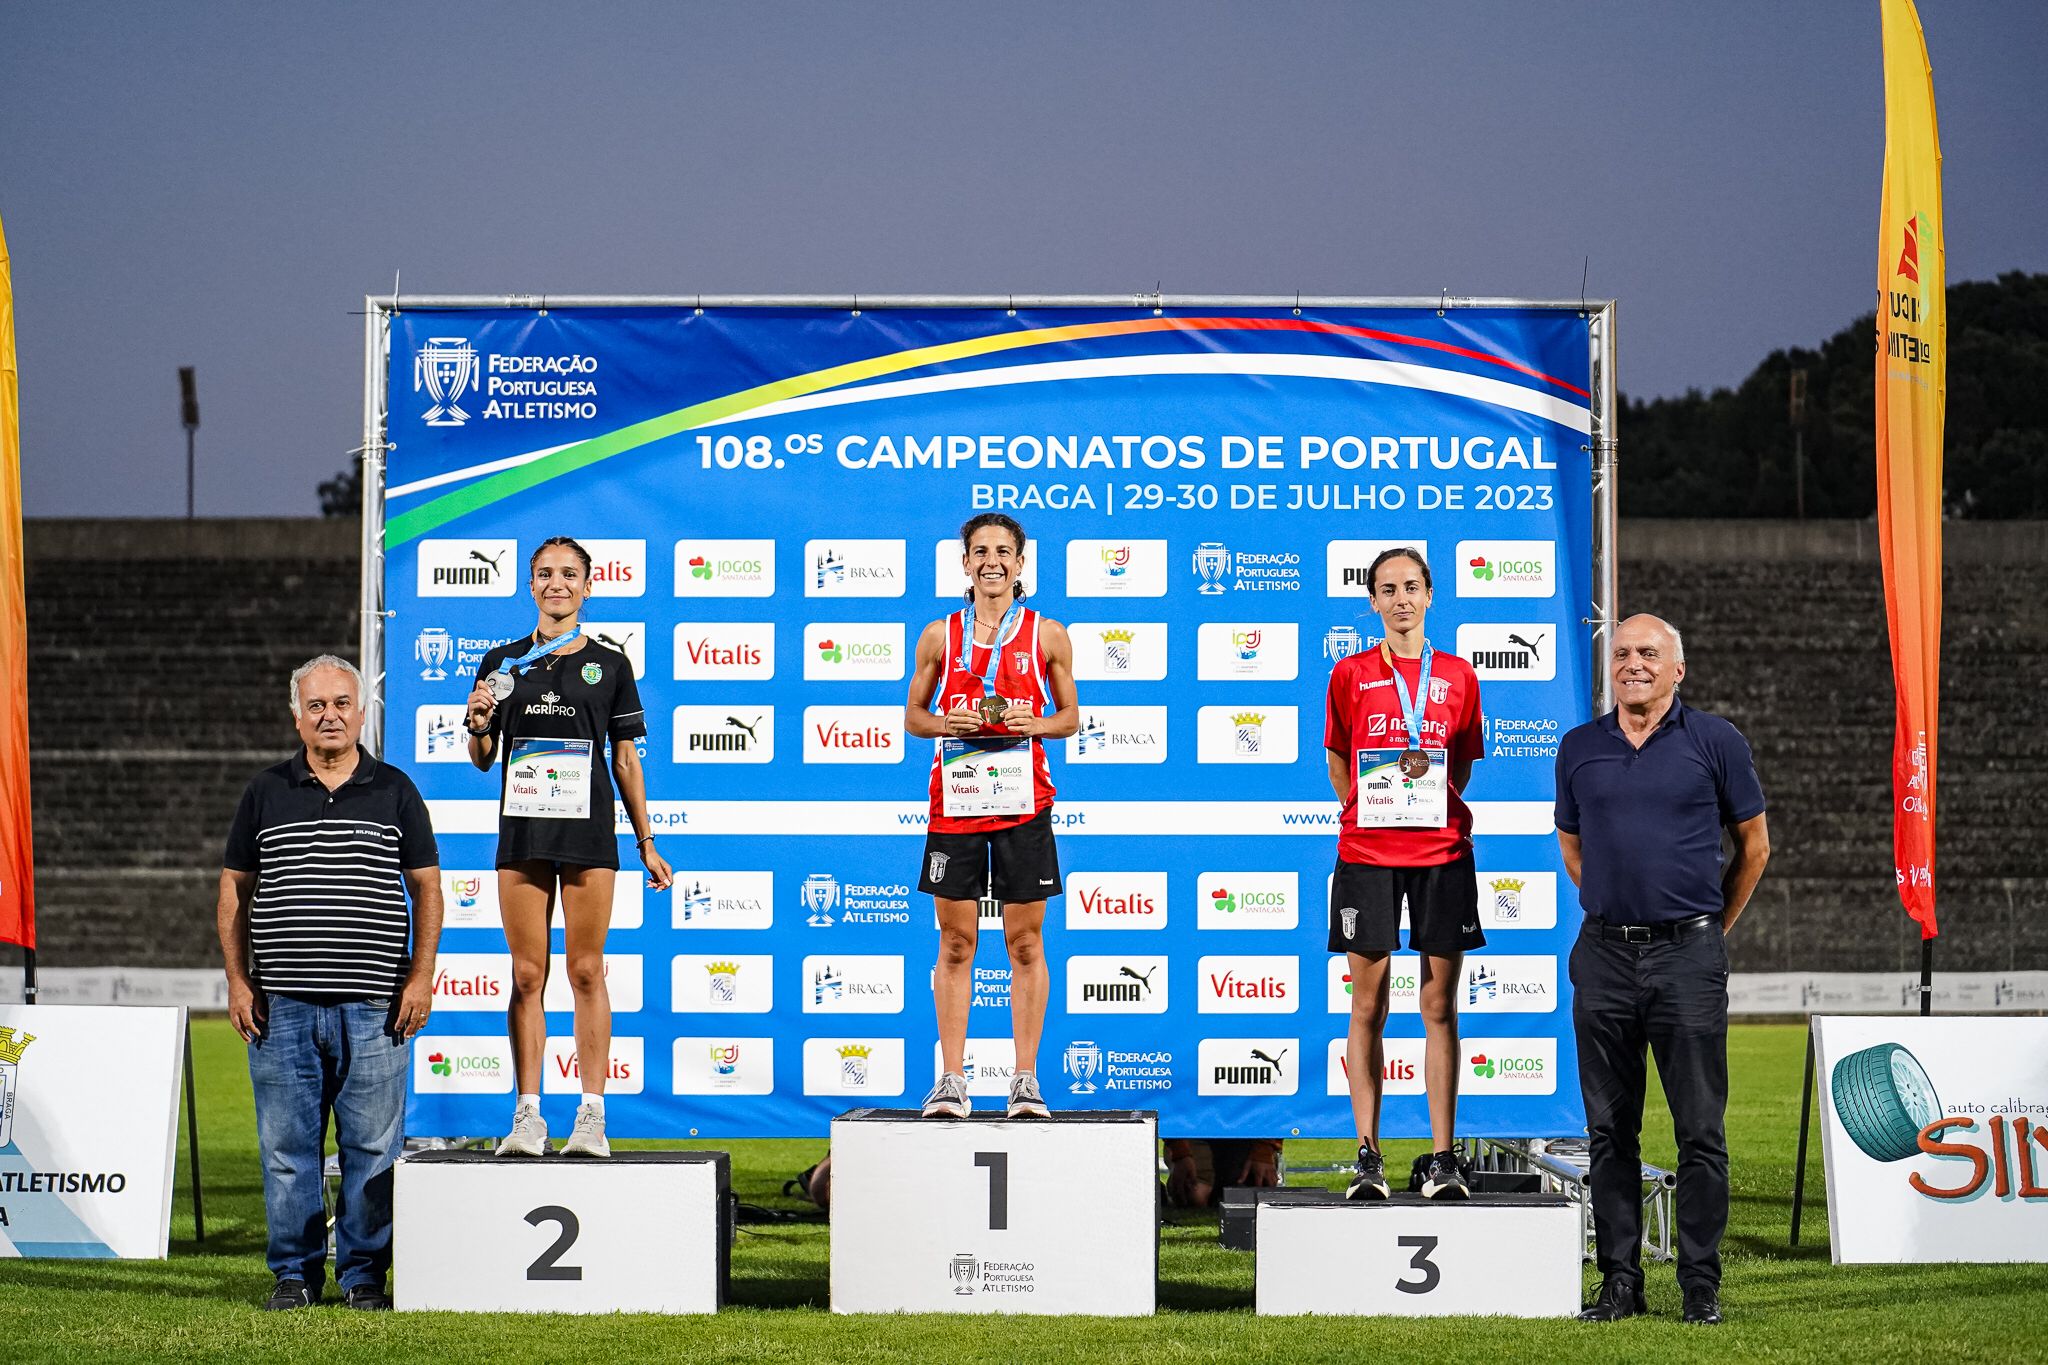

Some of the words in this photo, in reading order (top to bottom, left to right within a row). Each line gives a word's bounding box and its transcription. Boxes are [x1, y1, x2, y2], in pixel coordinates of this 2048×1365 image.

[488, 352, 598, 377] FEDERAÇÃO
[488, 377, 598, 396] PORTUGUESA
[483, 399, 598, 420] ATLETISMO
[836, 434, 1206, 470] CAMPEONATOS
[1221, 435, 1285, 470] DE
[1300, 435, 1558, 470] PORTUGAL
[972, 484, 1097, 509] BRAGA
[1124, 484, 1219, 510] 29-30
[1230, 484, 1278, 510] DE
[1286, 484, 1407, 510] JULHO
[1417, 485, 1466, 510] DE
[1474, 484, 1555, 511] 2023
[717, 559, 763, 574] JOGOS
[1236, 552, 1301, 567] FEDERAÇÃO
[433, 567, 491, 585] PUMA
[592, 561, 633, 581] alis
[850, 567, 894, 579] BRAGA
[1236, 566, 1301, 578] PORTUGUESA
[1343, 568, 1367, 585] PU
[1498, 561, 1544, 577] JOGOS
[1233, 580, 1301, 592] ATLETISMO
[687, 637, 762, 666] Vitalis
[846, 643, 892, 658] JOGOS
[1472, 651, 1529, 669] PUMA
[1359, 677, 1394, 691] hummel
[525, 703, 576, 717] AGRIPRO
[1390, 717, 1446, 738] naarra
[1495, 718, 1558, 732] FEDERAÇÃO
[816, 720, 892, 749] Vitalis
[1112, 734, 1156, 745] BRAGA
[1495, 733, 1558, 744] PORTUGUESA
[689, 734, 747, 751] PUMA
[1493, 746, 1558, 757] ATLETISMO
[952, 771, 975, 779] PUMA
[512, 783, 538, 795] Vitalis
[951, 783, 980, 794] Vitalis
[1367, 782, 1390, 790] PUMA
[1366, 794, 1394, 805] Vitalis
[845, 884, 910, 899] FEDERAÇÃO
[717, 900, 762, 911] BRAGA
[845, 898, 910, 910] PORTUGUESA
[1079, 886, 1154, 915] Vitalis
[1240, 893, 1286, 907] JOGOS
[842, 911, 910, 924] ATLETISMO
[849, 983, 893, 995] BRAGA
[1211, 970, 1286, 999] Vitalis
[1502, 983, 1546, 994] BRAGA
[1083, 984, 1140, 1002] PUMA
[456, 1056, 500, 1072] JOGOS
[1108, 1050, 1173, 1064] FEDERAÇÃO
[556, 1052, 631, 1080] Vilis
[1108, 1064, 1173, 1077] PORTUGUESA
[1498, 1058, 1544, 1073] JOGOS
[1214, 1066, 1272, 1085] PUMA
[1105, 1078, 1173, 1090] ATLETISMO
[4, 1092, 13, 1120] BRAGA
[1948, 1103, 1985, 1114] auto
[0, 1172, 126, 1194] TLETISMO
[973, 1152, 1008, 1230] 1
[523, 1205, 583, 1281] 2
[983, 1260, 1035, 1272] FEDERAÇÃO
[1395, 1235, 1441, 1295] 3
[983, 1272, 1035, 1282] PORTUGUESA
[982, 1283, 1035, 1293] ATLETISMO
